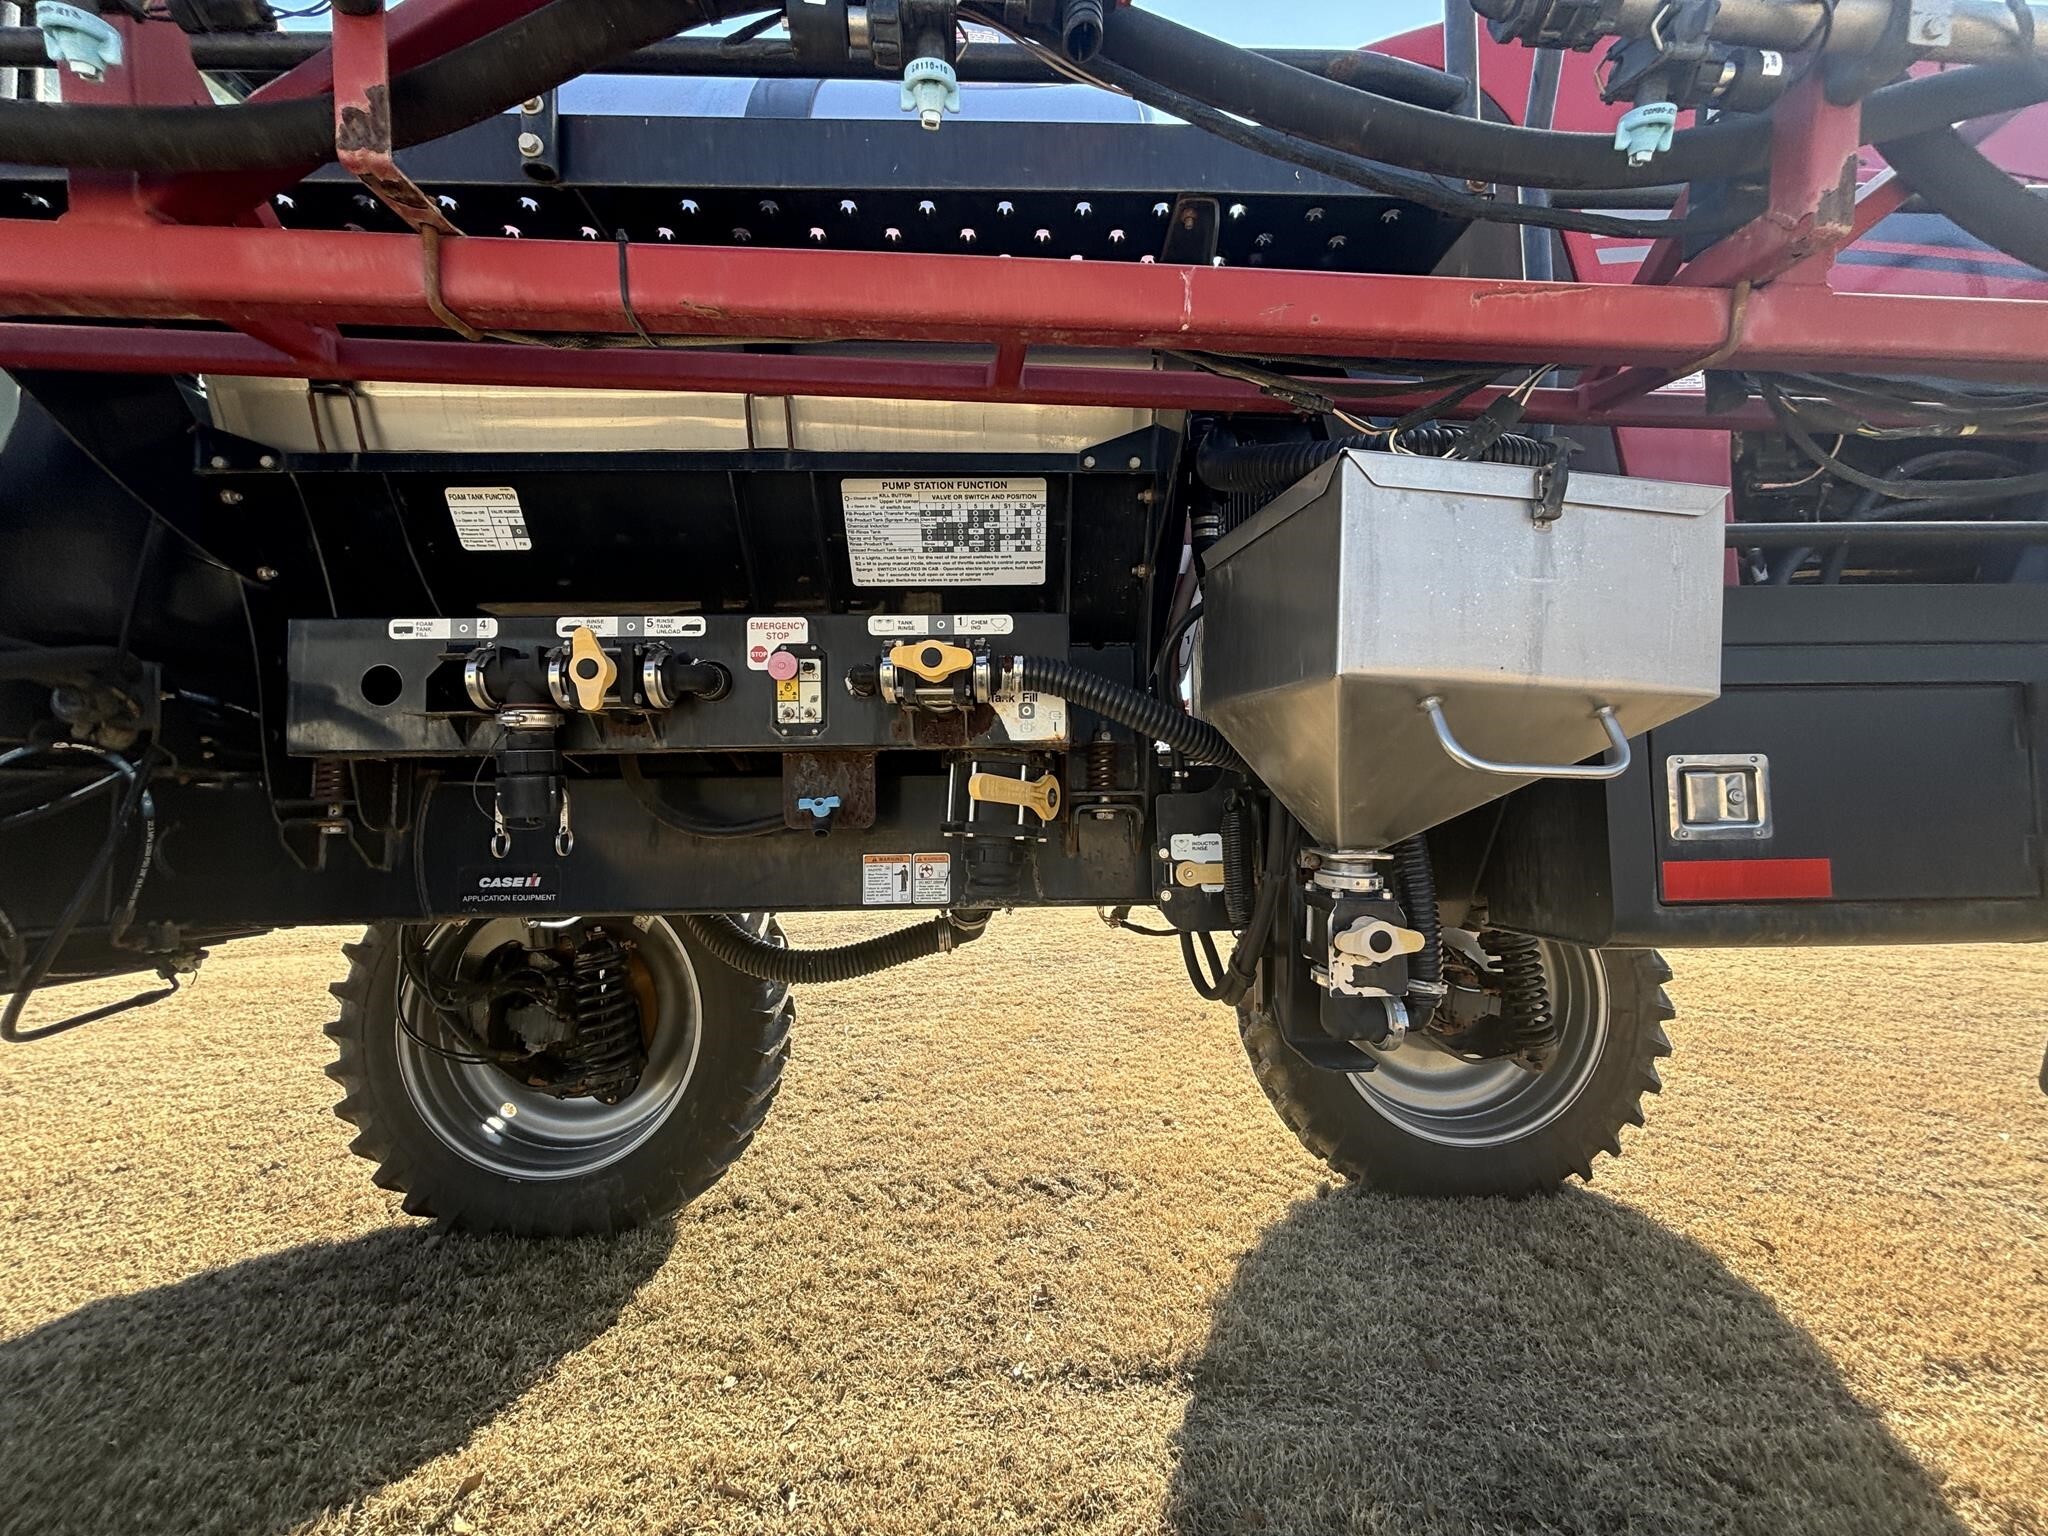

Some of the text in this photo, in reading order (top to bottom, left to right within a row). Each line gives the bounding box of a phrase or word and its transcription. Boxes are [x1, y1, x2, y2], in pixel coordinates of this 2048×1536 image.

[882, 480, 1008, 490] PUMP STATION FUNCTION
[479, 620, 487, 629] 4
[646, 618, 654, 627] 5
[958, 616, 962, 626] 1
[750, 622, 806, 630] EMERGENCY
[766, 632, 790, 640] STOP
[989, 692, 1038, 702] Tak Fill
[479, 877, 525, 888] CASE
